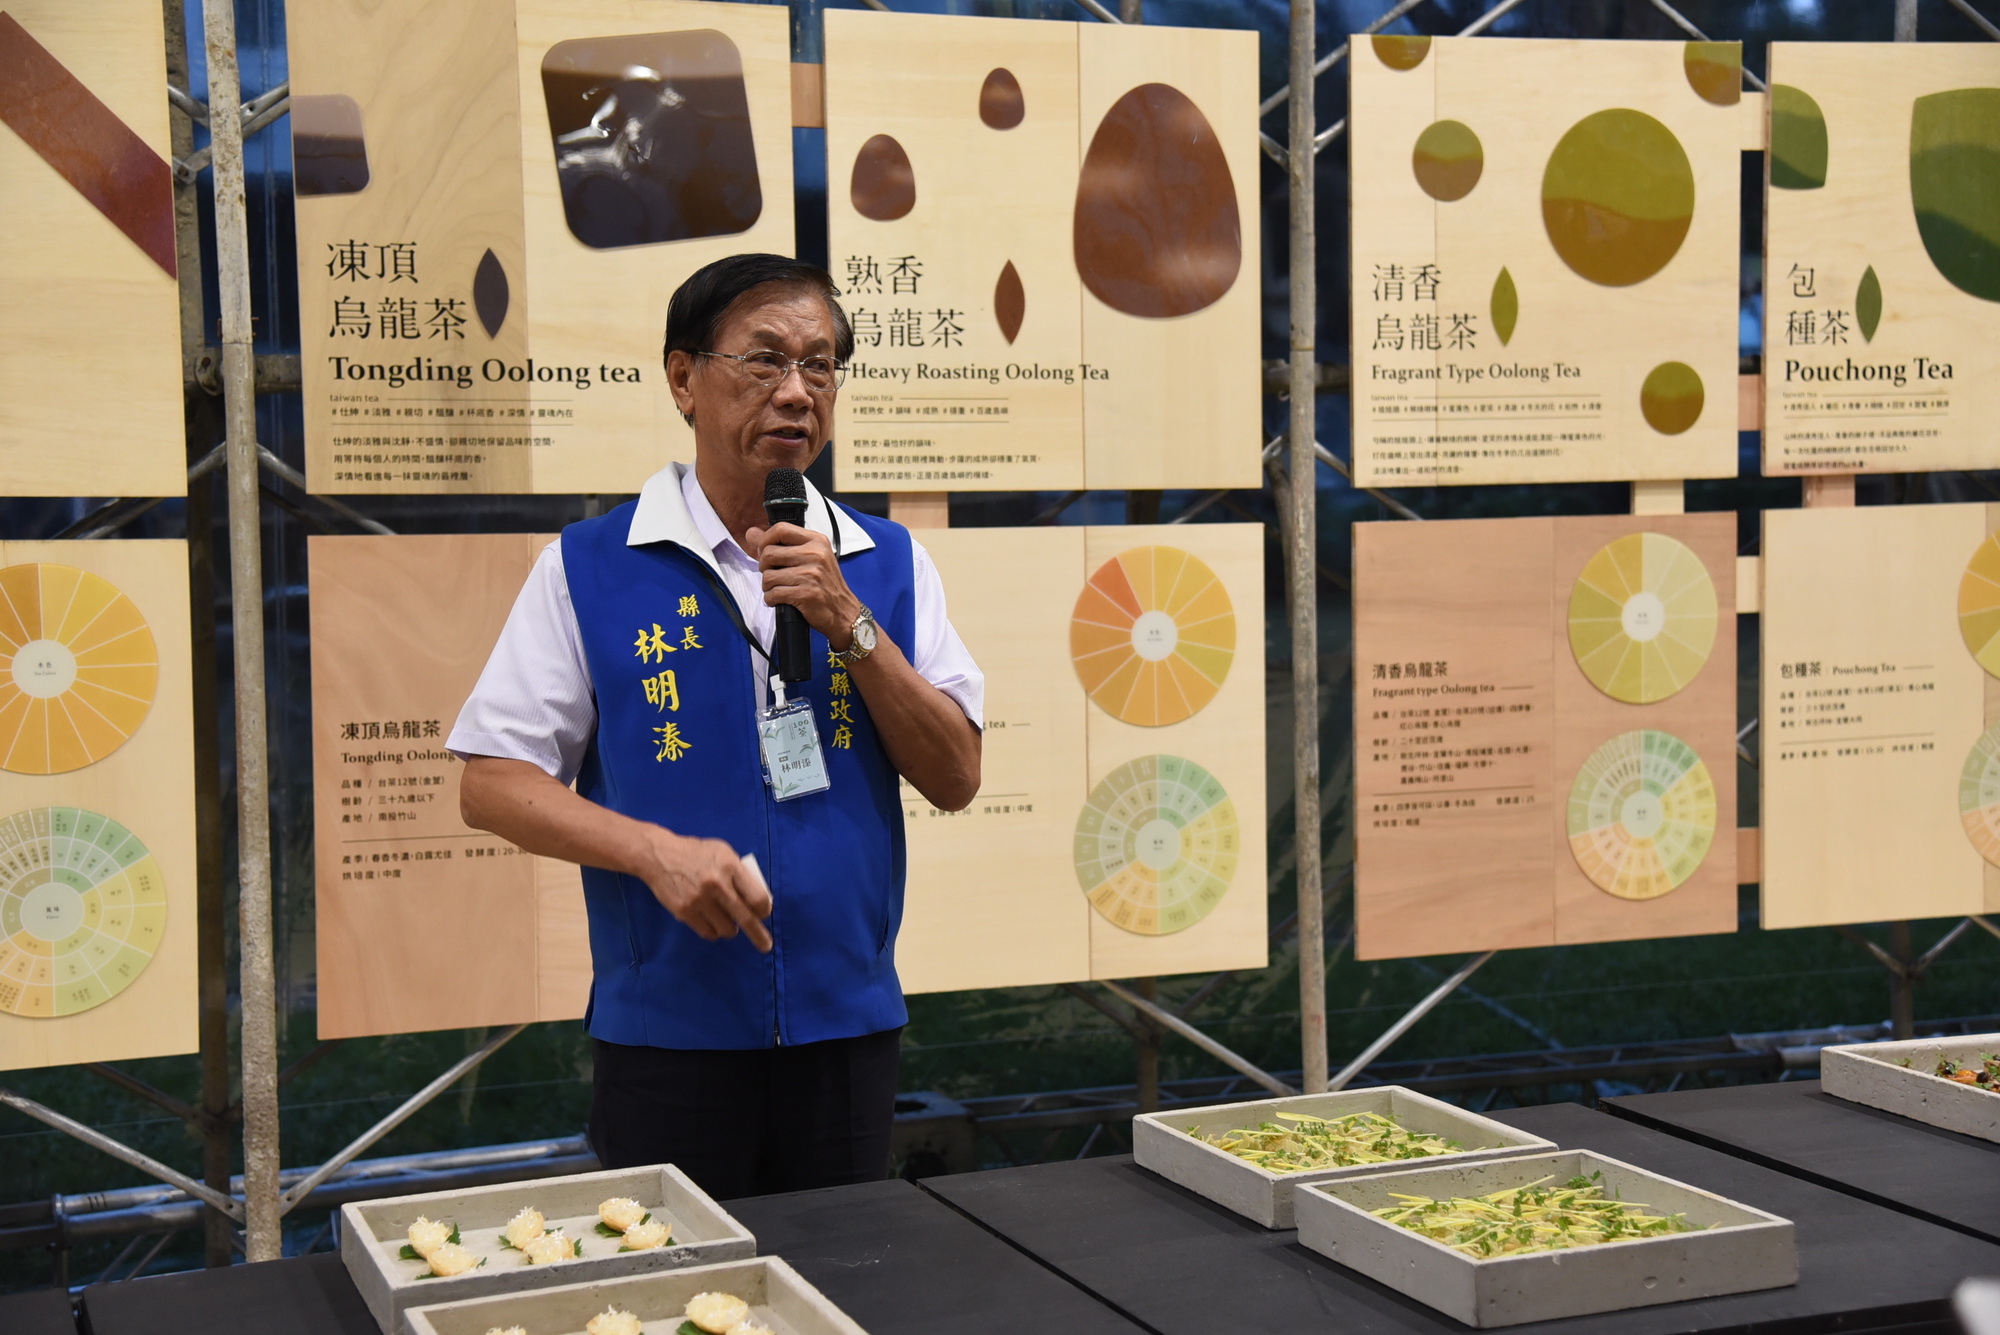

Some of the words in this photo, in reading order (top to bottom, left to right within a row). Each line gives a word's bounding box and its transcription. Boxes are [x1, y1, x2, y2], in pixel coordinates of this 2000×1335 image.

[325, 239, 419, 284] 凍頂
[845, 255, 924, 295] 熟香
[1371, 263, 1442, 302] 清香
[1786, 262, 1817, 298] 包
[329, 296, 468, 341] 烏龍茶
[850, 307, 965, 349] 烏龍茶
[1371, 312, 1478, 351] 烏龍茶
[1784, 309, 1851, 347] 種茶
[328, 356, 473, 388] Tongding
[482, 357, 591, 390] Oolong
[599, 362, 642, 383] tea
[852, 362, 911, 384] Heavy
[917, 362, 1000, 385] Roasting
[1005, 362, 1075, 385] Oolong
[1078, 363, 1110, 380] Tea
[1371, 364, 1442, 385] Fragrant
[1445, 363, 1485, 384] Type
[1489, 362, 1550, 382] Oolong
[1553, 362, 1581, 378] Tea
[1784, 357, 1908, 388] Pouchong
[1913, 357, 1954, 380] Tea
[329, 393, 362, 403] taiwan
[364, 394, 380, 403] tea
[851, 393, 879, 402] taiwan
[881, 393, 894, 402] tea
[676, 593, 704, 651] 縣長
[1372, 661, 1448, 680] 清香烏龍茶
[1832, 663, 1879, 676] Pouchong
[1881, 662, 1896, 673] Tea
[633, 622, 692, 763] 林明溱
[1372, 685, 1415, 698] Fragrant
[1416, 684, 1438, 697] type
[1440, 683, 1478, 696] Oolong
[1480, 684, 1495, 693] tea
[340, 719, 441, 741] 凍頂烏龍茶
[989, 720, 1006, 729] tea
[341, 751, 404, 766] Tongding
[406, 748, 456, 763] Oolong
